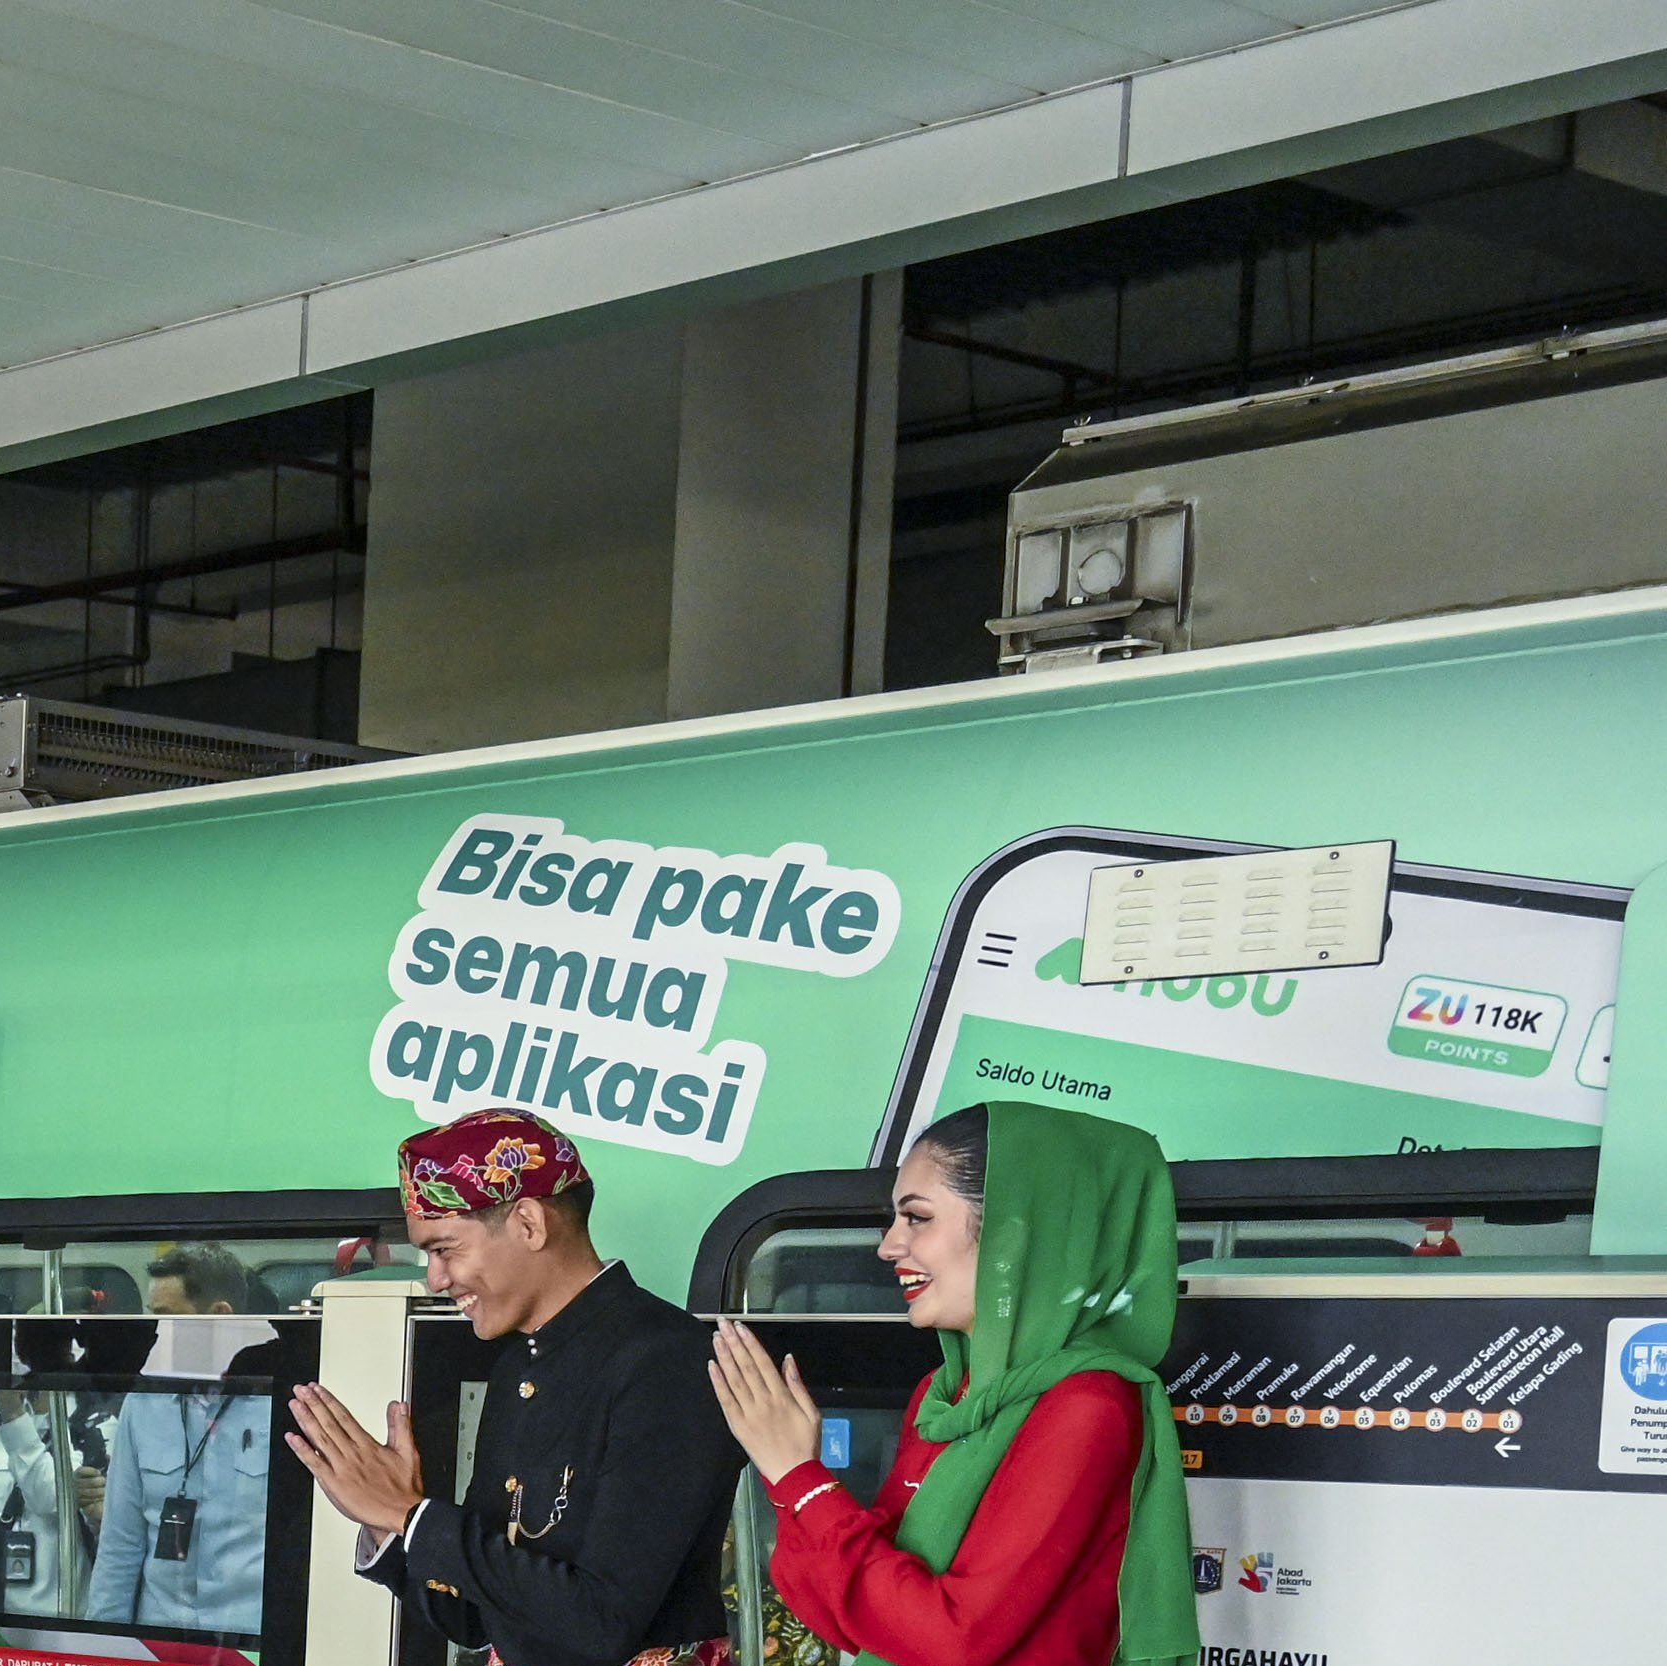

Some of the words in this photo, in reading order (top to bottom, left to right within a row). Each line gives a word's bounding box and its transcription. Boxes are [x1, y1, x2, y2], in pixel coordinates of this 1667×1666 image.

[438, 828, 633, 917] Bisa
[632, 863, 879, 956] pake
[405, 927, 707, 1033] semua
[1407, 987, 1469, 1025] ZU
[1474, 1003, 1543, 1034] 118K
[1425, 1039, 1510, 1066] POINTS
[386, 1019, 745, 1144] aplikasi
[976, 1058, 1035, 1086] Saldo
[1041, 1070, 1112, 1101] Utama
[1189, 1351, 1241, 1400] Proklamasi
[1222, 1356, 1272, 1400] Matraman
[1289, 1343, 1356, 1401] Rawamangun
[1323, 1353, 1378, 1401] Velodrome
[1359, 1355, 1413, 1403] Equestrian
[1429, 1357, 1481, 1404] Boulevard
[1478, 1326, 1520, 1363] Selatan
[1465, 1350, 1519, 1396] Boulevard
[1517, 1326, 1548, 1353] Utara
[1475, 1347, 1542, 1405] Summarecon
[1539, 1325, 1566, 1353] Mall
[1506, 1373, 1546, 1406] Kelapa
[1542, 1341, 1583, 1376] Gading
[1255, 1362, 1299, 1401] Pramuka
[1392, 1364, 1439, 1404] Pulomas
[1190, 1413, 1200, 1422] 10
[1222, 1413, 1233, 1422] 09
[1256, 1414, 1267, 1423] 08
[1289, 1414, 1300, 1423] 07
[1324, 1415, 1335, 1424] 06
[1359, 1416, 1370, 1425] 05
[1394, 1417, 1406, 1426] 04
[1430, 1417, 1441, 1426] 03
[1466, 1418, 1478, 1427] 02
[1503, 1419, 1515, 1428] 01
[1182, 1454, 1197, 1465] 17
[1276, 1567, 1303, 1578] Abad
